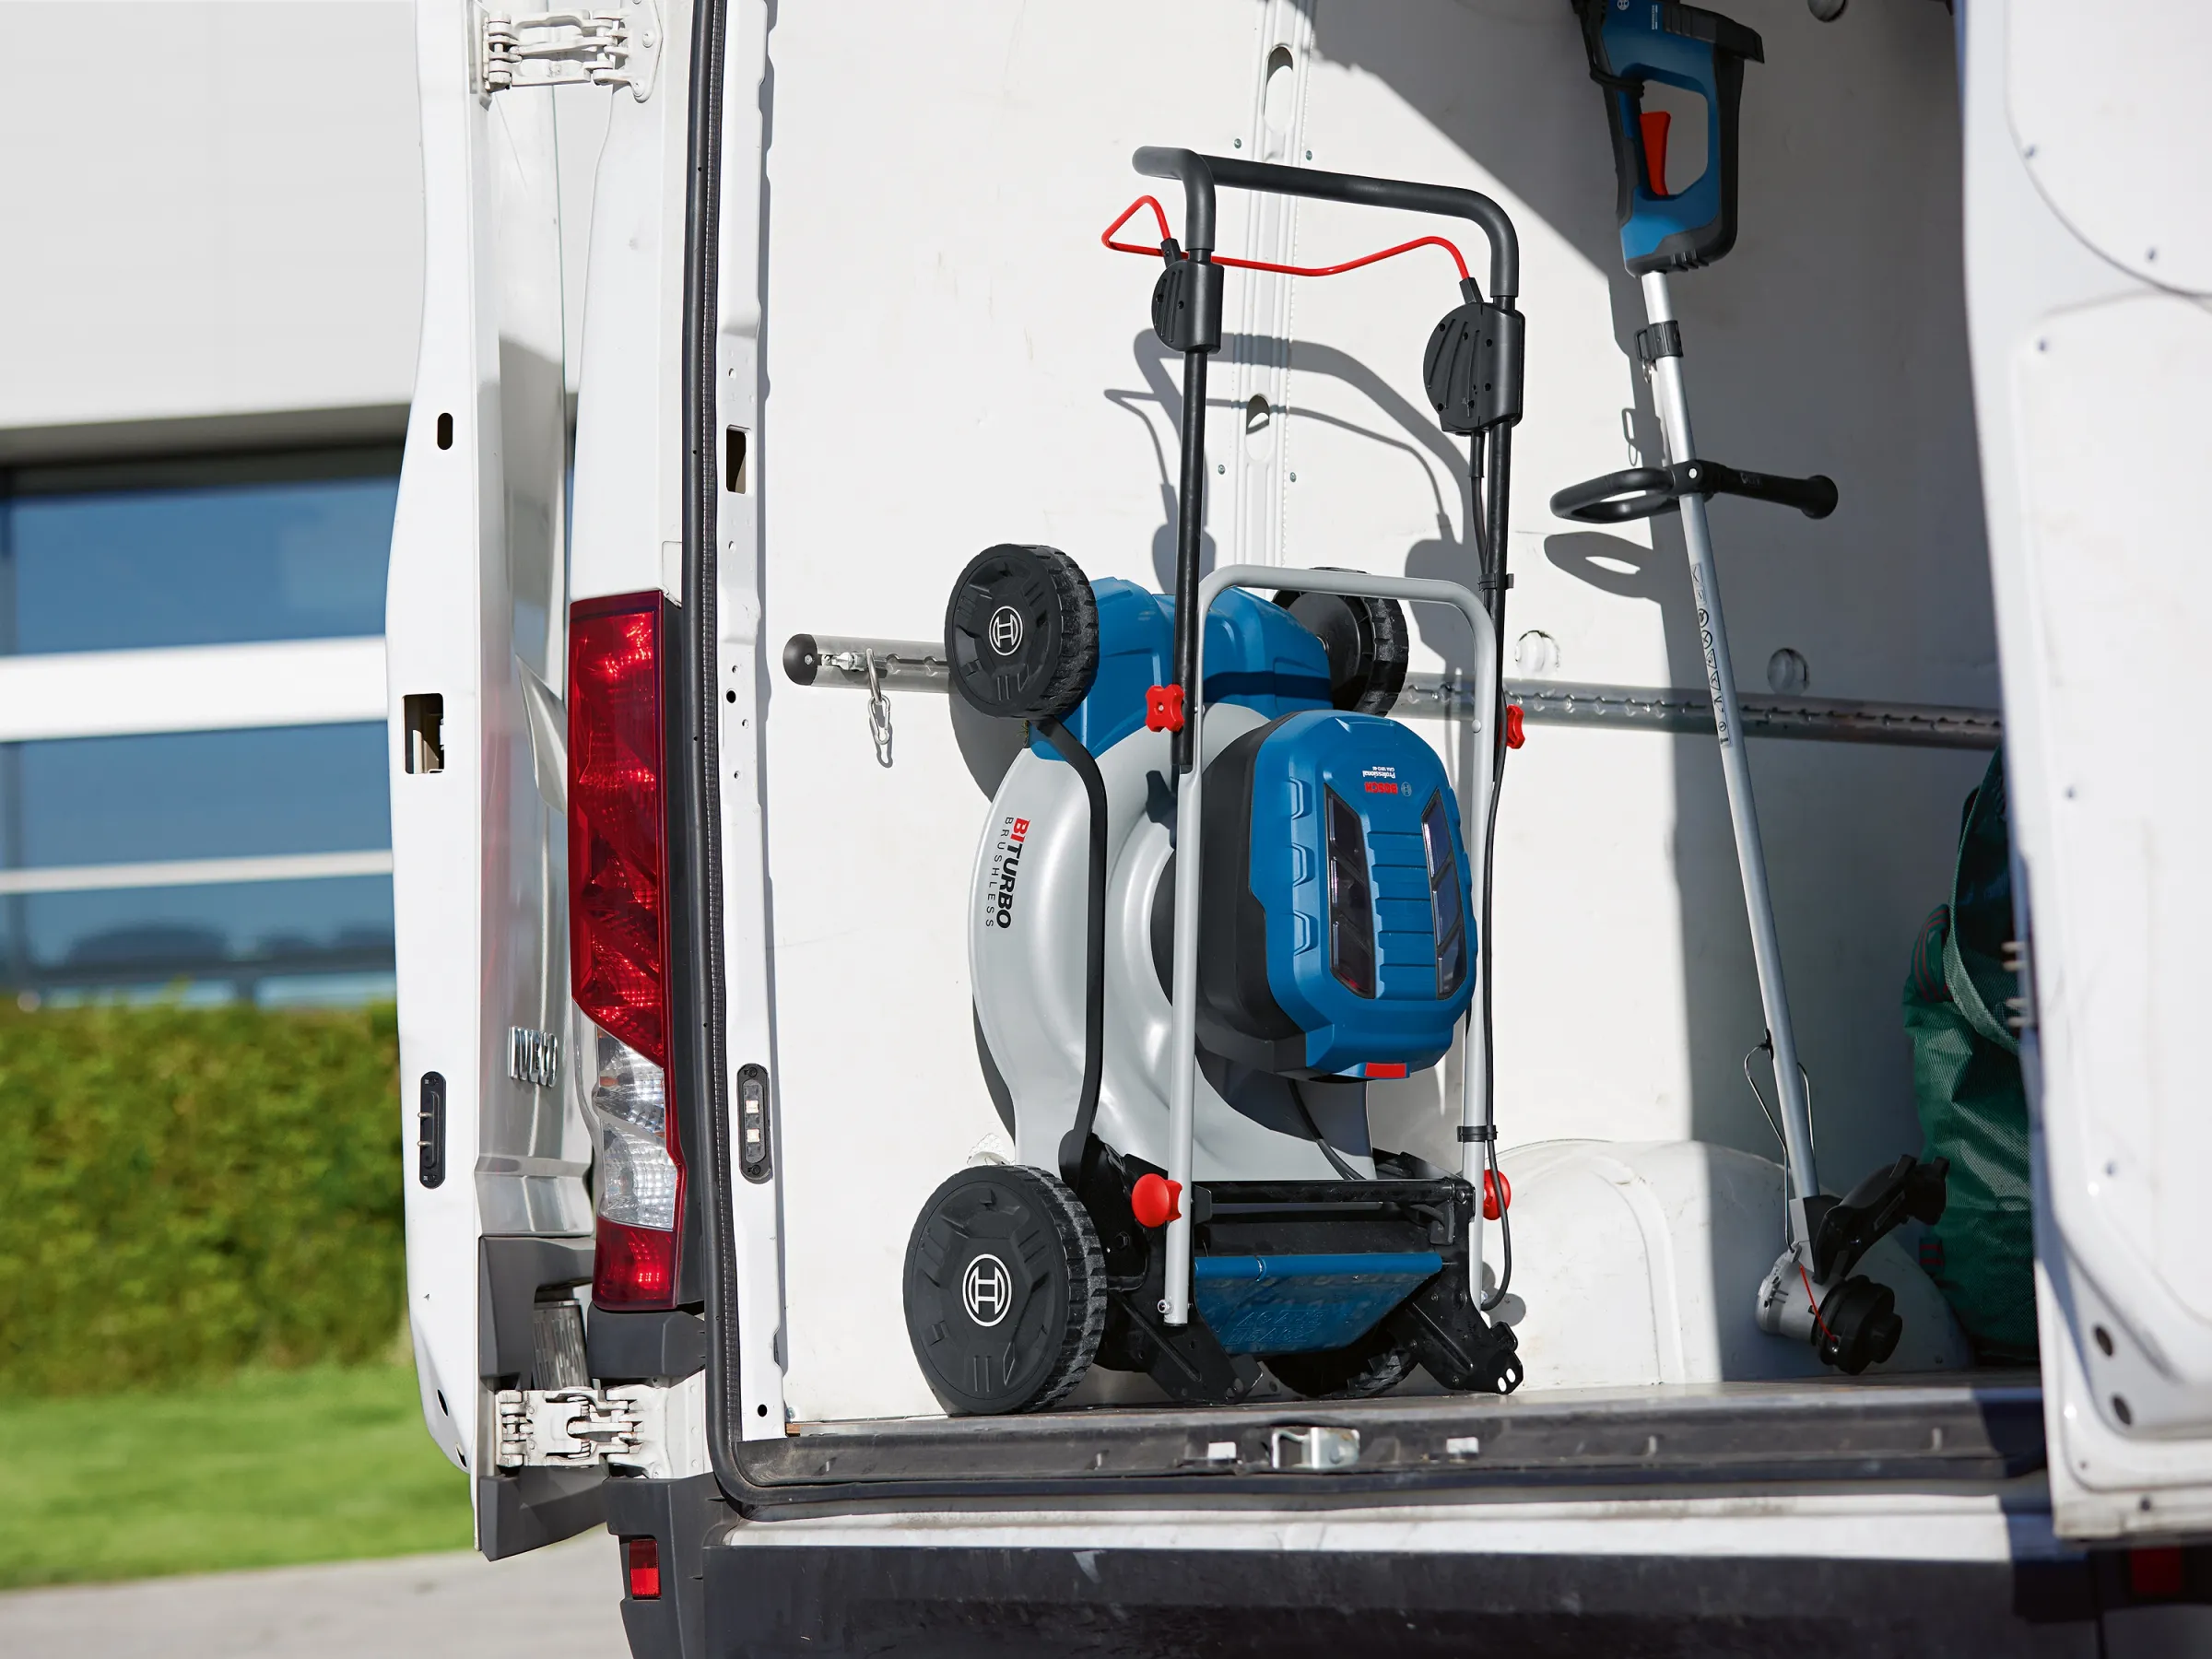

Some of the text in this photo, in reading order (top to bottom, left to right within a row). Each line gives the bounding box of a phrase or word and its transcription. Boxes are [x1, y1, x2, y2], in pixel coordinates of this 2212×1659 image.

[1362, 771, 1396, 779] Professional
[1364, 782, 1398, 794] BOSCH
[985, 817, 1014, 927] BRUSHLESS
[996, 818, 1030, 929] BITURBO
[508, 1026, 558, 1088] IVECO
